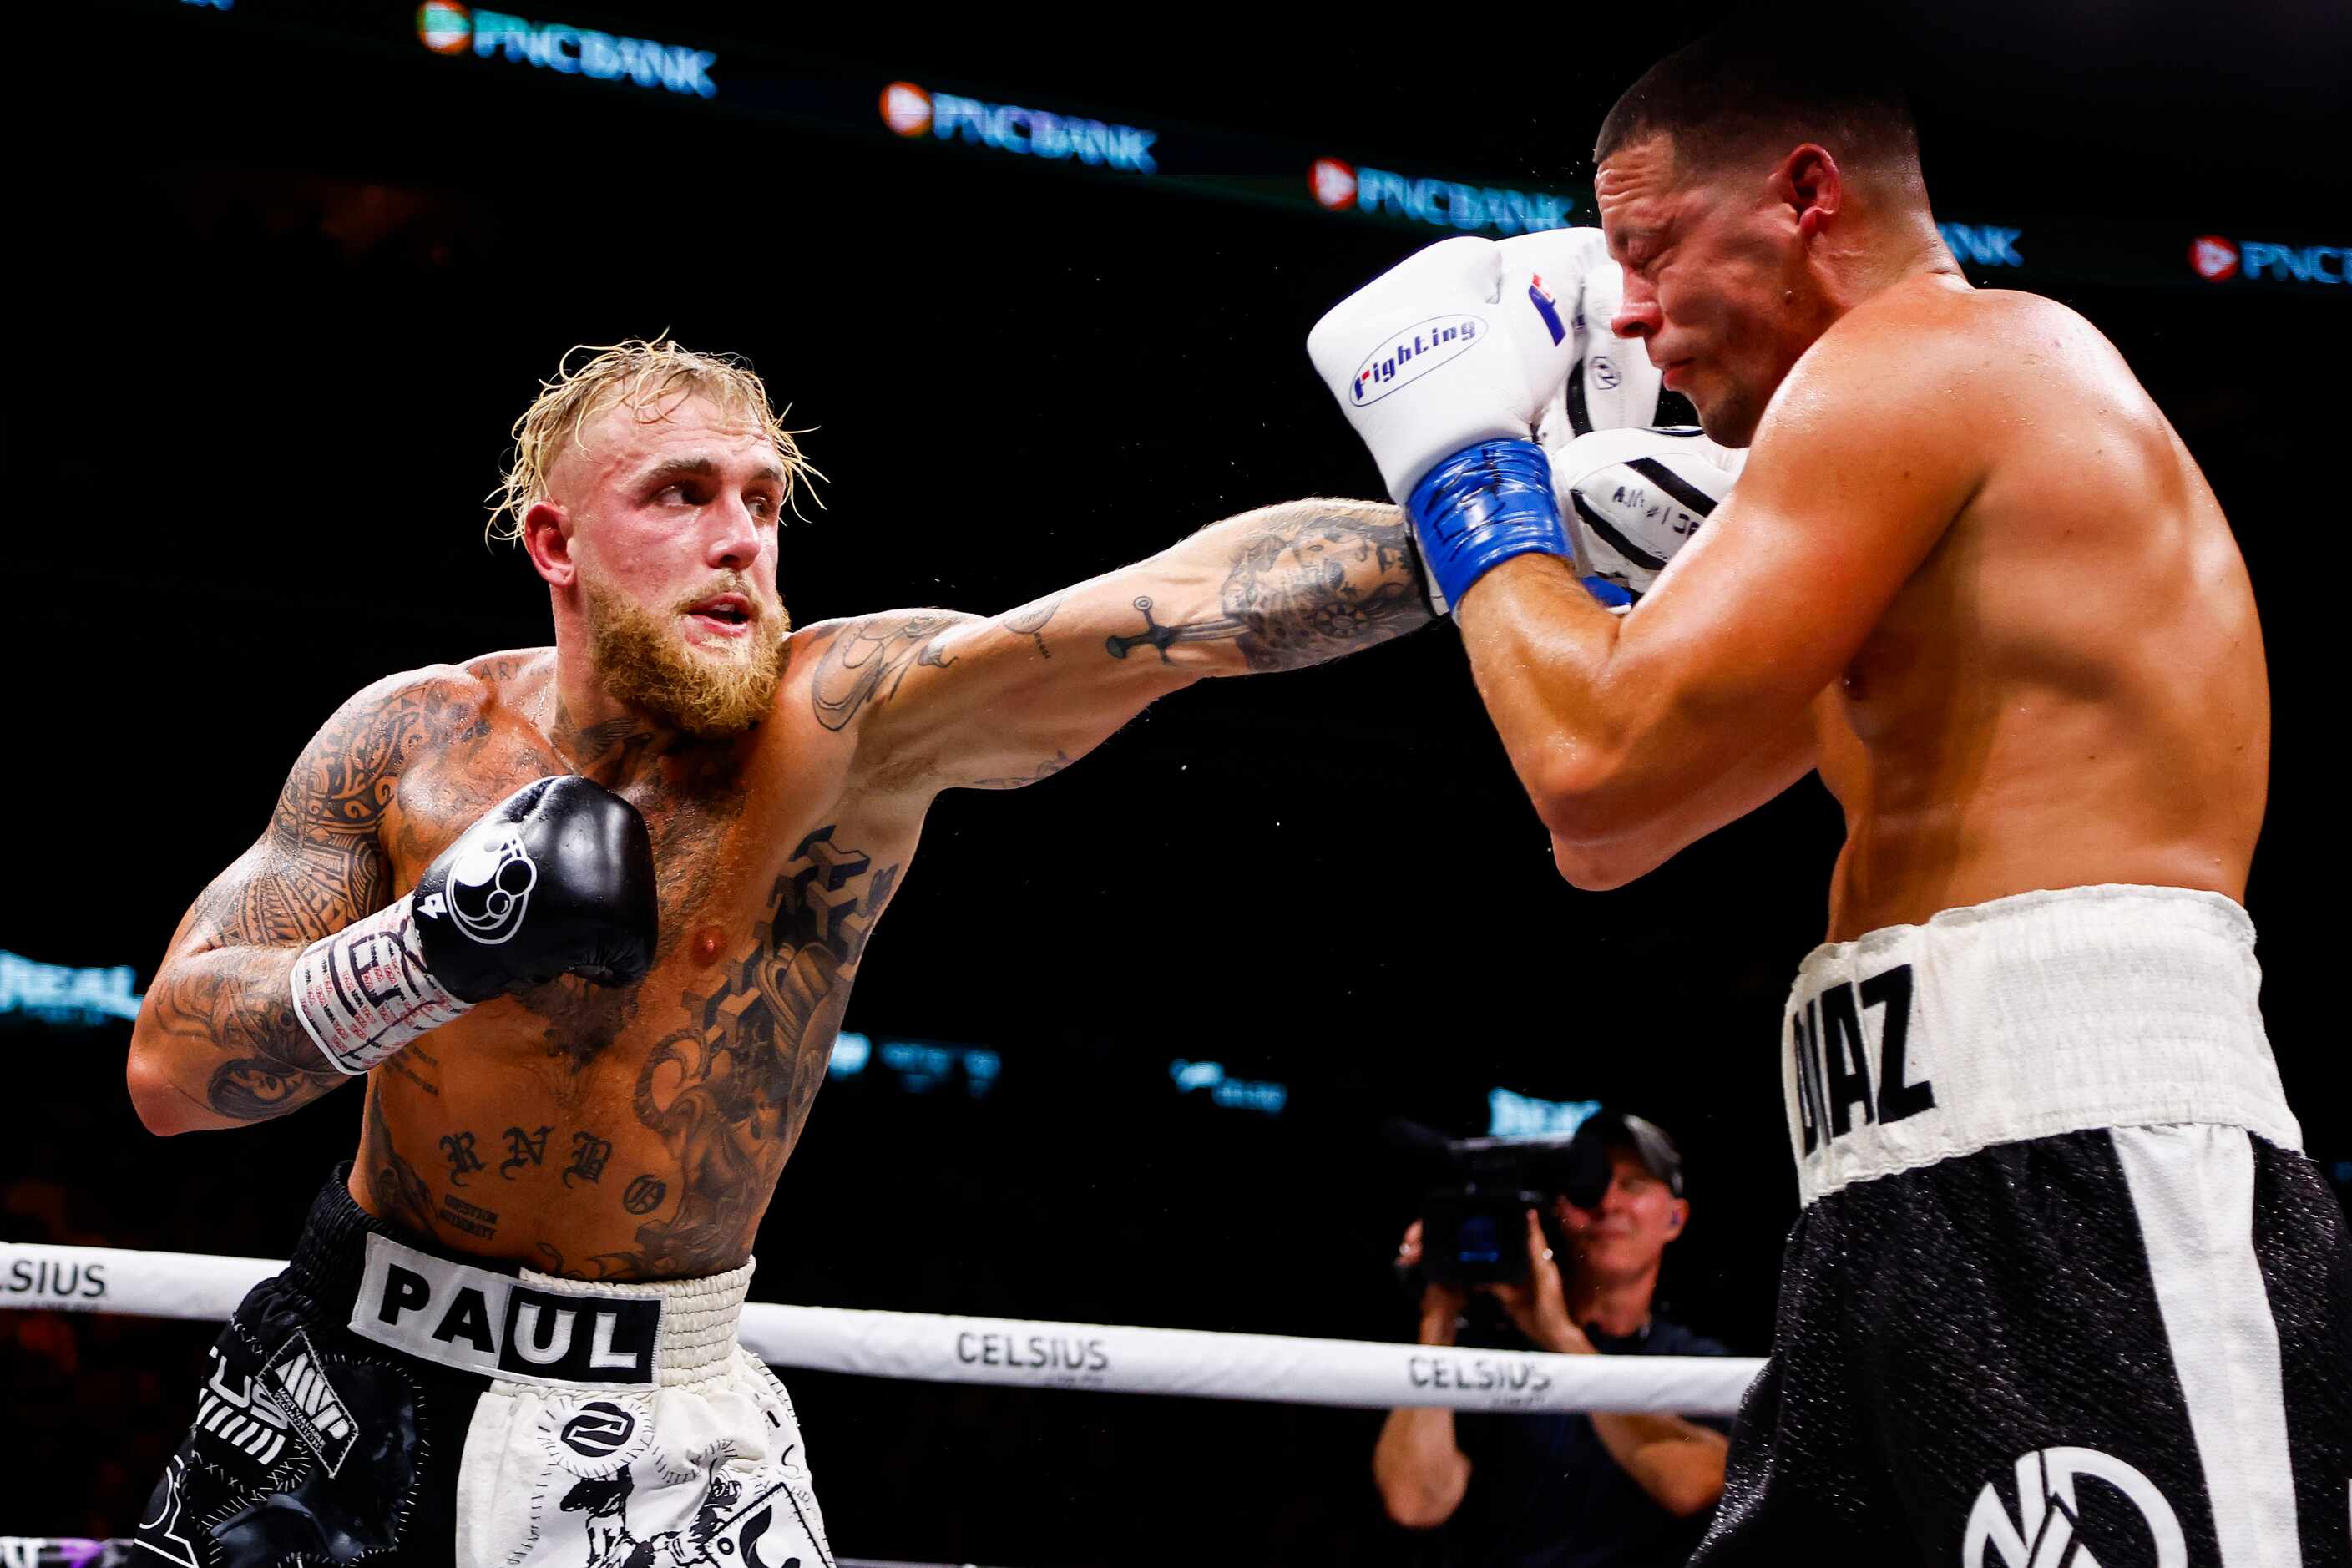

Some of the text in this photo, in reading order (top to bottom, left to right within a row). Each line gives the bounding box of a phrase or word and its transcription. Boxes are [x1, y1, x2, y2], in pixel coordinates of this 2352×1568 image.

[1353, 321, 1476, 402] Fighting
[0, 1259, 106, 1299] SIUS
[377, 1262, 638, 1370] PAUL
[958, 1331, 1108, 1372] CELSIUS
[1409, 1355, 1552, 1393] CELSIUS
